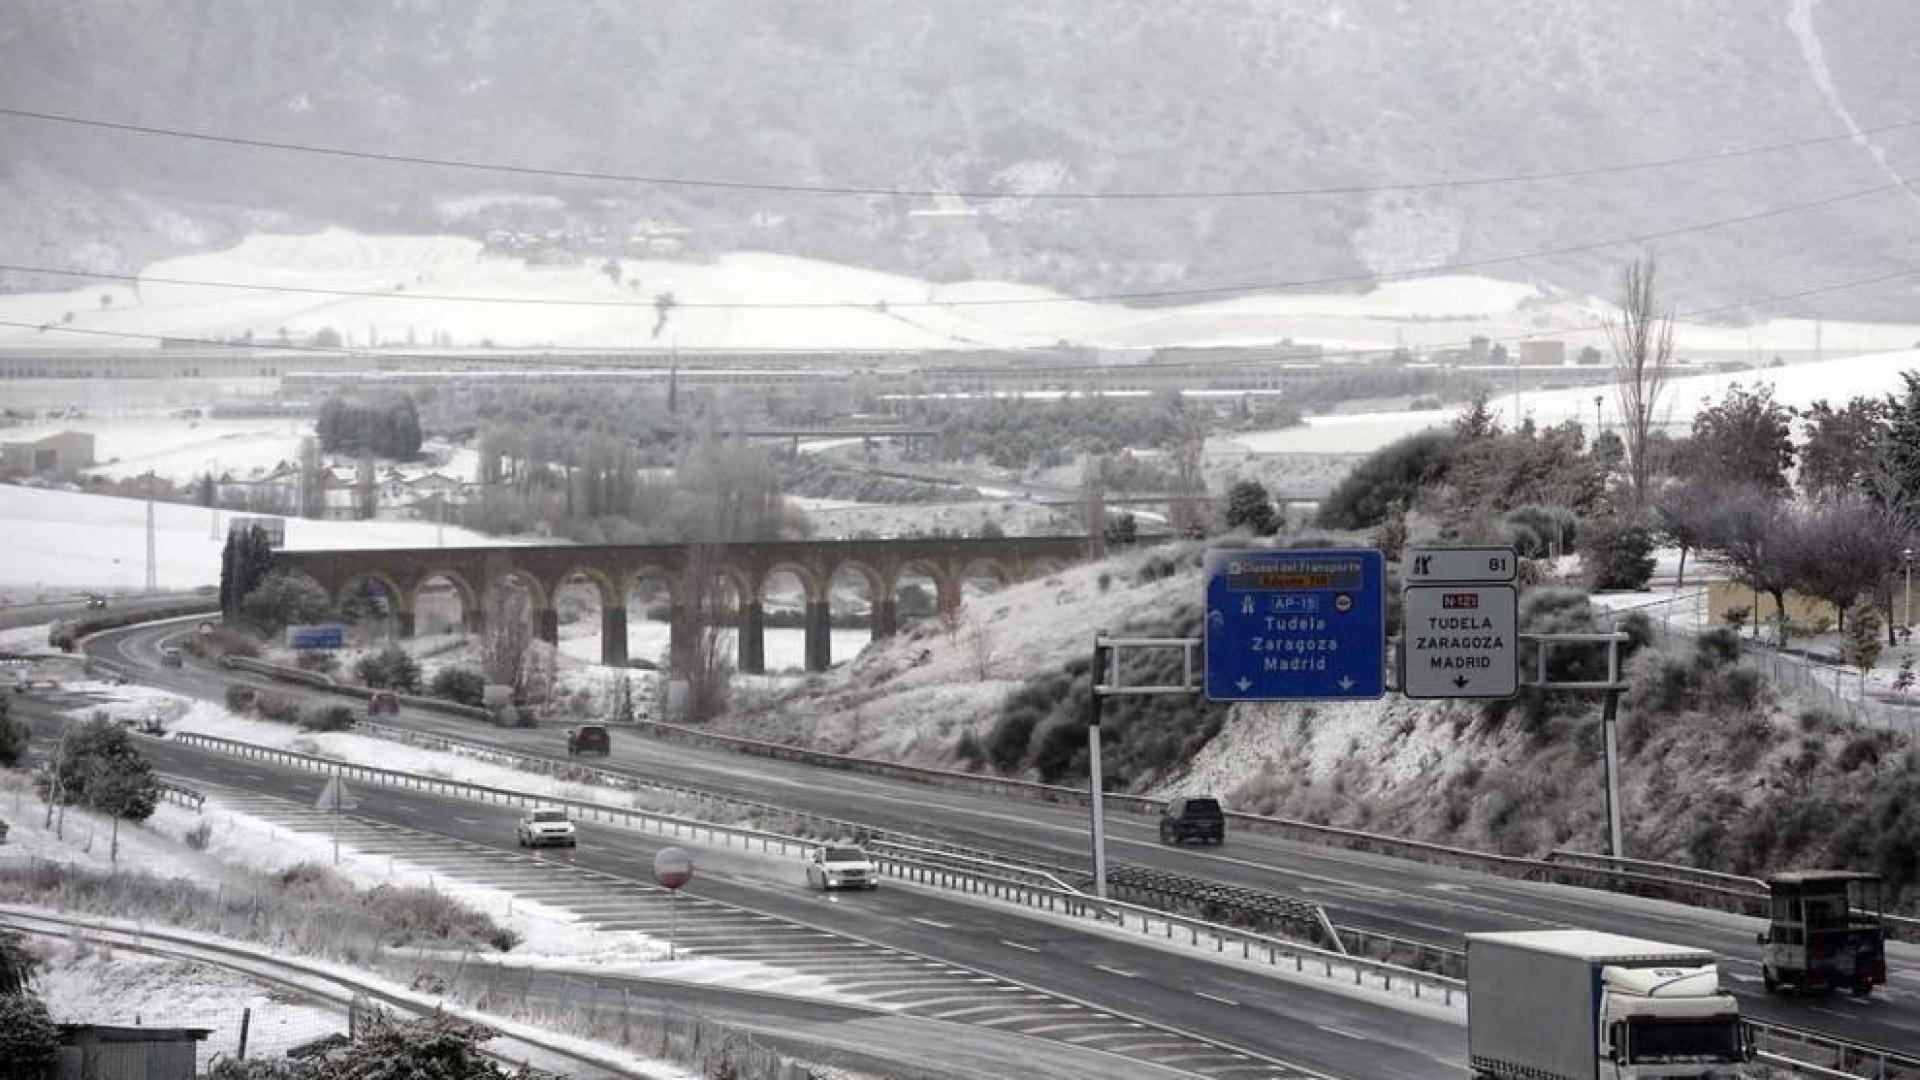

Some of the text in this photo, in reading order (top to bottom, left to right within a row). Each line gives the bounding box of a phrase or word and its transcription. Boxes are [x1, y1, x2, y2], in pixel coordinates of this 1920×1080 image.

[1488, 558, 1506, 571] 81
[1275, 596, 1316, 610] AP-15
[1265, 615, 1326, 631] Tudela
[1428, 617, 1492, 630] TUDELA
[1252, 637, 1338, 653] Zaragoza
[1416, 637, 1503, 649] ZARAGOZA
[1264, 656, 1326, 671] Madrid
[1430, 656, 1490, 668] MADRID
